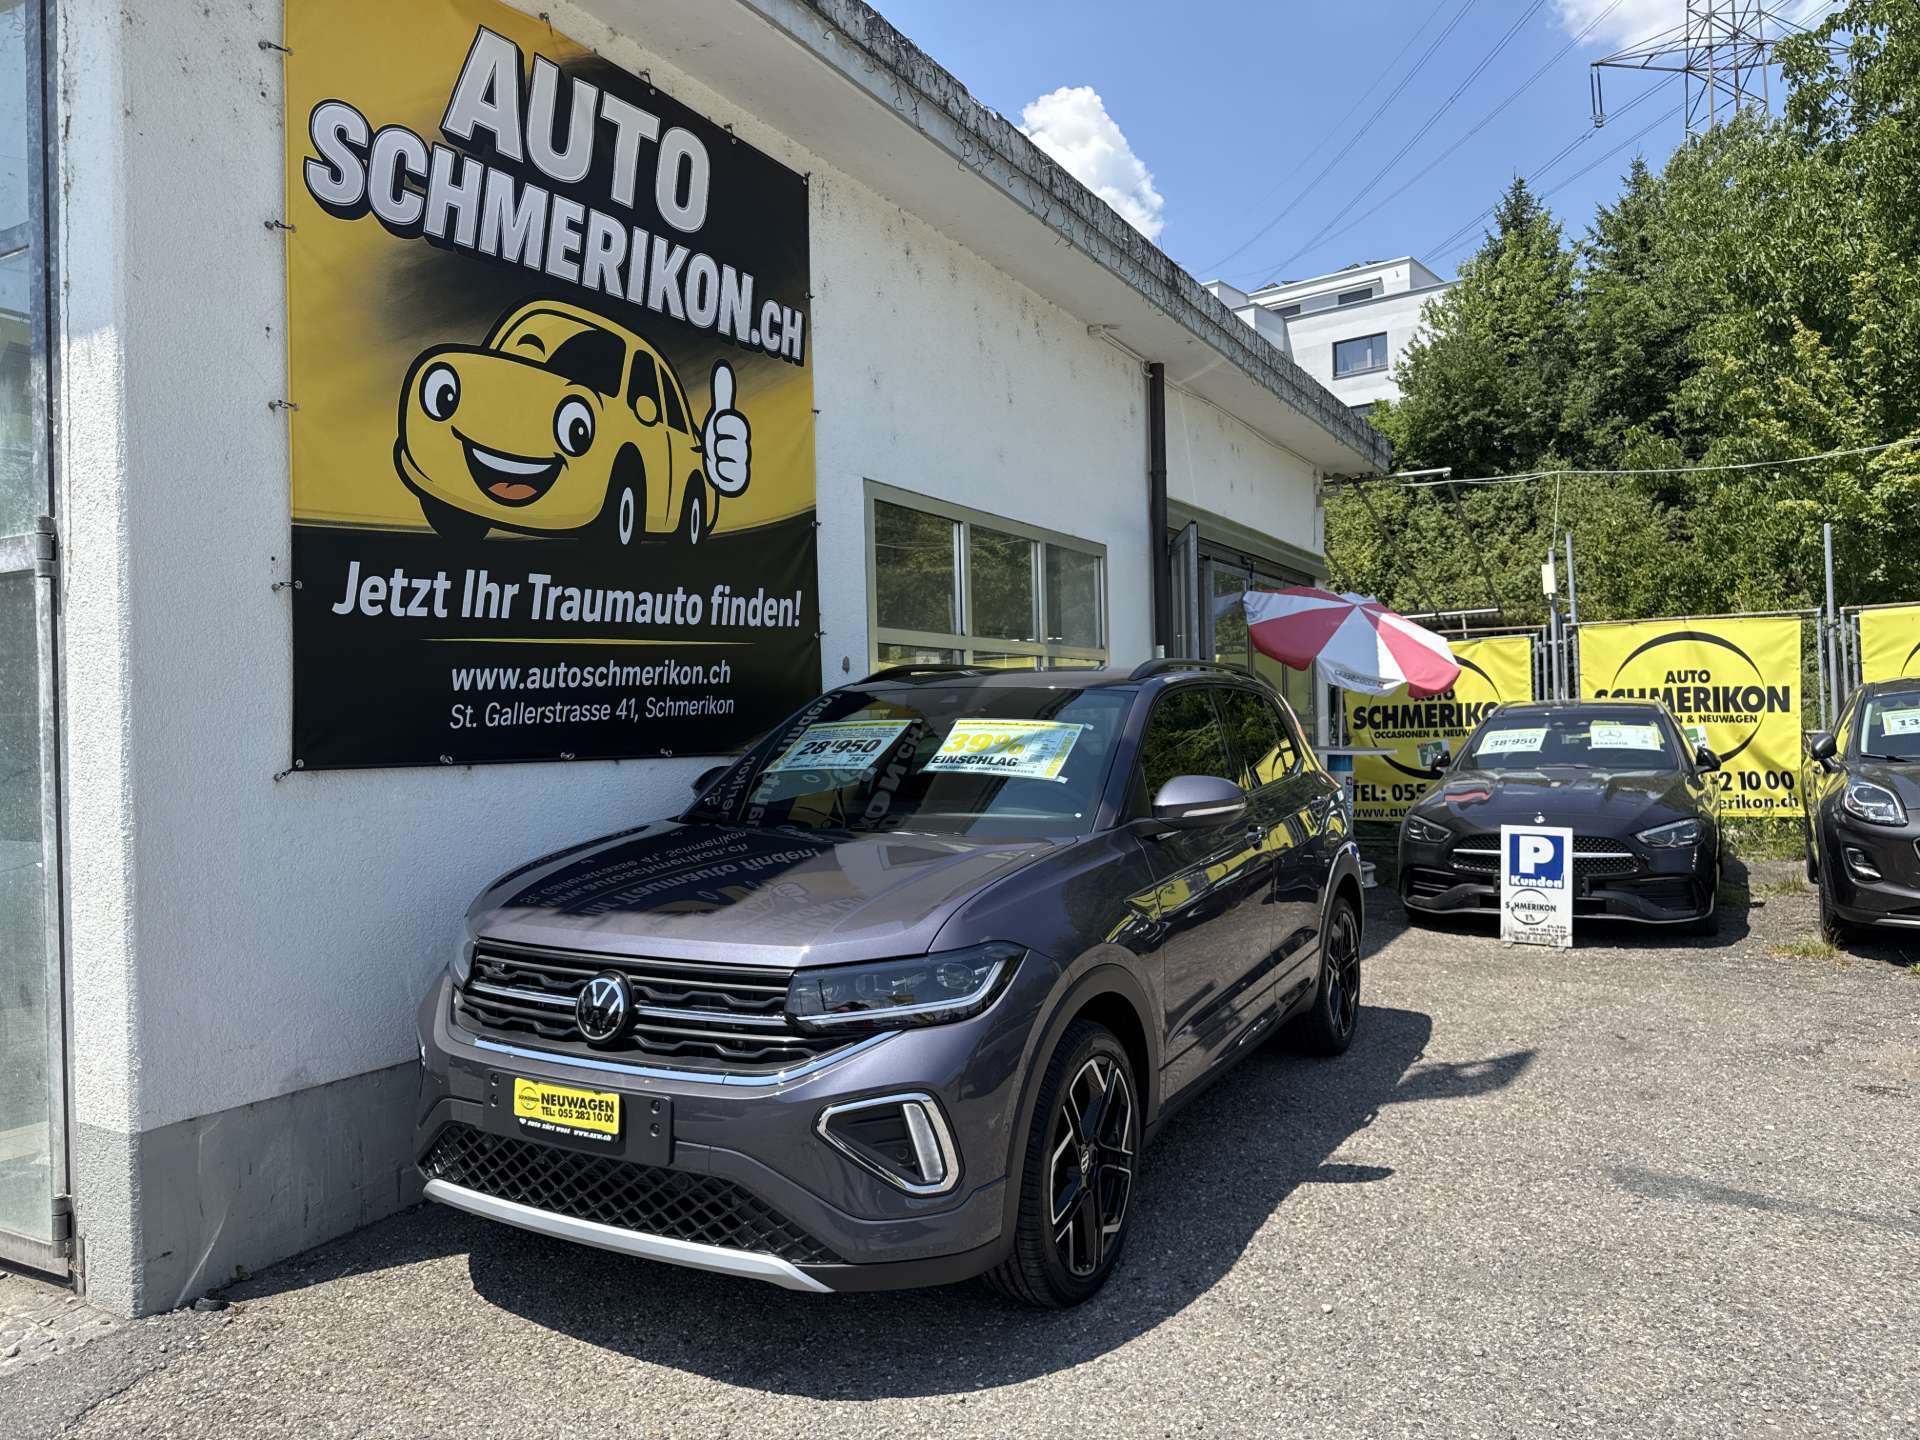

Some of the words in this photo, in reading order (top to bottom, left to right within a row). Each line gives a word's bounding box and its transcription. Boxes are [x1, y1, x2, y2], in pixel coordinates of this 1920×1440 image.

[441, 24, 712, 233] AUTO
[305, 101, 806, 361] SCHMERIKON.CH
[331, 561, 452, 619] Jetzt
[462, 569, 520, 620] Ihr
[528, 573, 702, 625] Traumauto
[710, 587, 802, 628] finden!
[451, 658, 731, 692] www.autoschmerikon.ch
[1664, 669, 1711, 684] AUTO
[449, 703, 478, 729] St.
[485, 701, 611, 727] Gallerstrasse
[616, 698, 640, 724] 41,
[645, 696, 735, 720] Schmerikon
[1687, 714, 1696, 723] &
[1699, 714, 1758, 724] NEUWAGEN
[1374, 729, 1430, 739] OCCASIONEN
[1433, 730, 1440, 738] &
[797, 739, 883, 756] 28'950
[943, 733, 1025, 755] 39%
[931, 755, 1018, 767] EINSCHLAG
[1738, 771, 1761, 791] 10
[1765, 770, 1794, 790] 00
[1353, 784, 1387, 802] TEL:
[1510, 875, 1563, 889] Kunden
[1505, 901, 1557, 912] SHMERIKON
[541, 1093, 615, 1113] NEUWAGEN
[541, 1107, 556, 1117] TEL:
[558, 1109, 573, 1119] 055
[575, 1111, 591, 1121] 282
[593, 1113, 602, 1121] 10
[604, 1114, 614, 1123] 00
